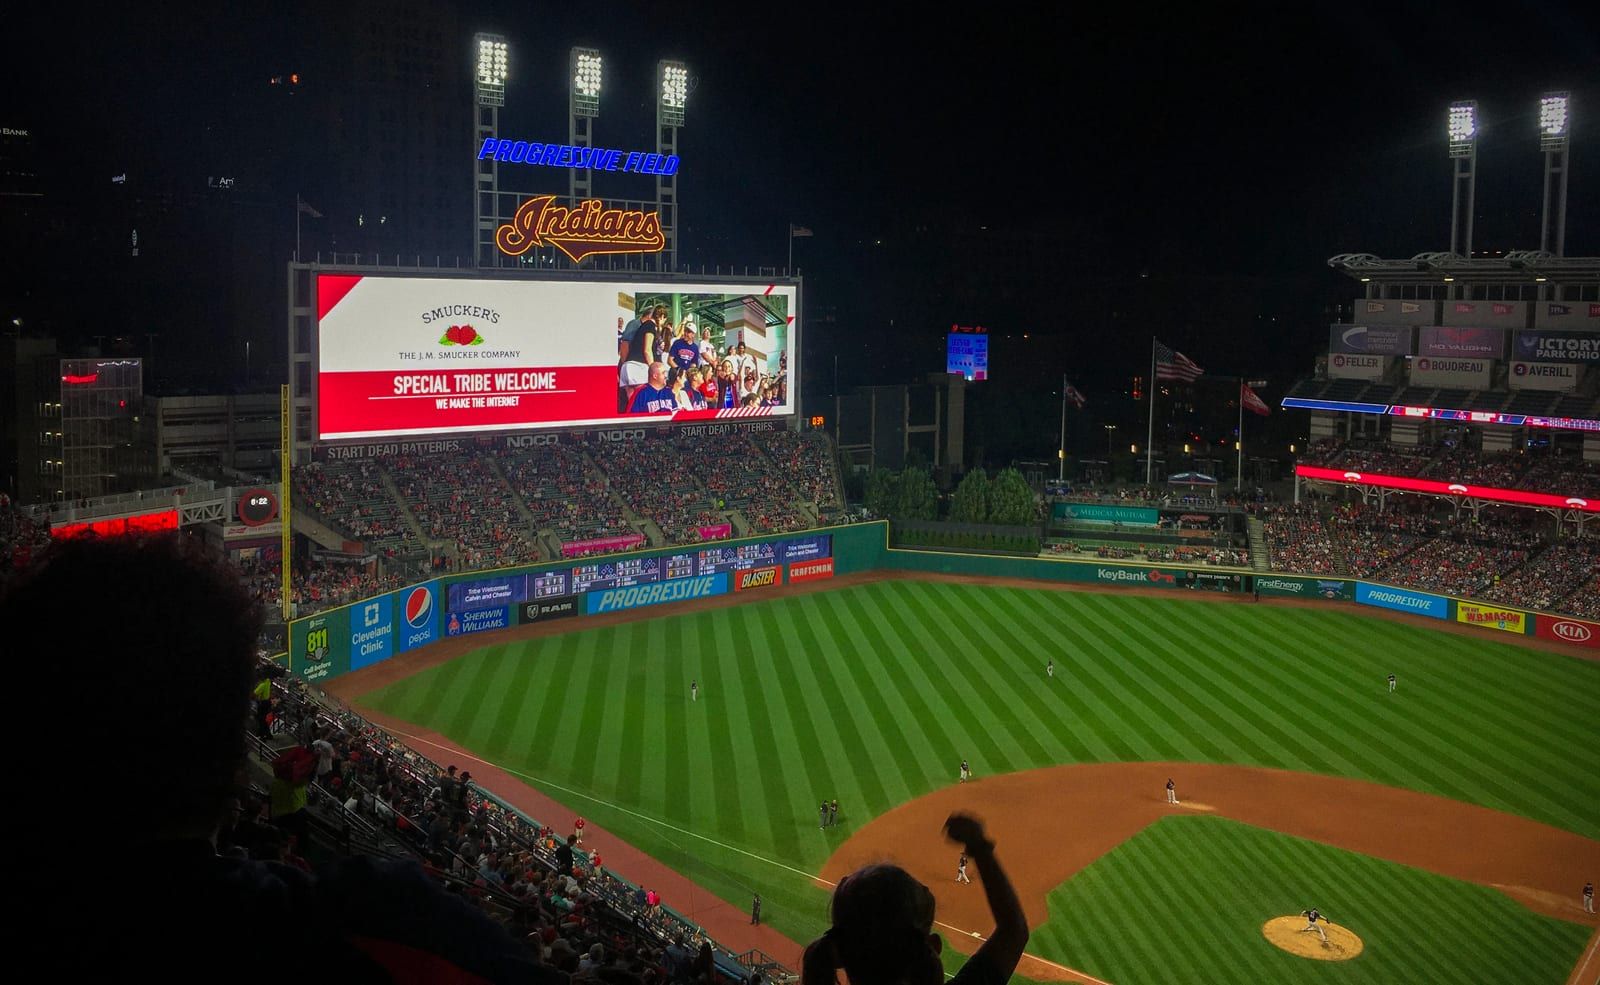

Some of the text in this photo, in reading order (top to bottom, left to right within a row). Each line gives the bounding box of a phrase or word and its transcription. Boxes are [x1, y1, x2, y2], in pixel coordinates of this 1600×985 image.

[2, 127, 29, 136] BANK
[478, 137, 681, 176] PROGRESSIVE FIELD
[496, 195, 666, 259] Indians
[421, 304, 500, 324] SMUCKER'S
[399, 352, 417, 360] THE
[438, 351, 479, 360] SMUCKER
[481, 350, 521, 358] COMPANY
[1536, 349, 1600, 360] PARK OHIO
[1346, 358, 1378, 368] FELLER
[1431, 360, 1483, 373] BOUDREAU
[1529, 365, 1573, 378] AVERILL
[393, 372, 556, 394] SPECIAL TRIBE WELCOME
[436, 396, 520, 409] WE MAKE THE INTERNET
[598, 428, 646, 442] NOCO
[681, 426, 708, 438] START
[506, 434, 559, 448] NOCO
[327, 445, 365, 459] START
[368, 443, 398, 457] DEAD
[1080, 508, 1149, 519] MEDICAL MUTUAL
[790, 563, 833, 577] CRAFTSMAN
[1097, 568, 1148, 582] KeyBank
[742, 570, 776, 588] BLASTER
[482, 584, 509, 593] Welcomes!
[599, 577, 715, 611] PROGRESSIVE
[465, 594, 482, 602] Calvin
[493, 590, 512, 598] Chester
[1368, 590, 1432, 610] PROGRESSIVE
[463, 608, 504, 622] SHERWIN
[541, 603, 572, 614] RAM
[352, 622, 392, 645] Cleveland
[408, 628, 431, 647] pepsi
[1558, 624, 1585, 638] KIA
[306, 627, 329, 653] 811
[360, 639, 384, 656] Clinic
